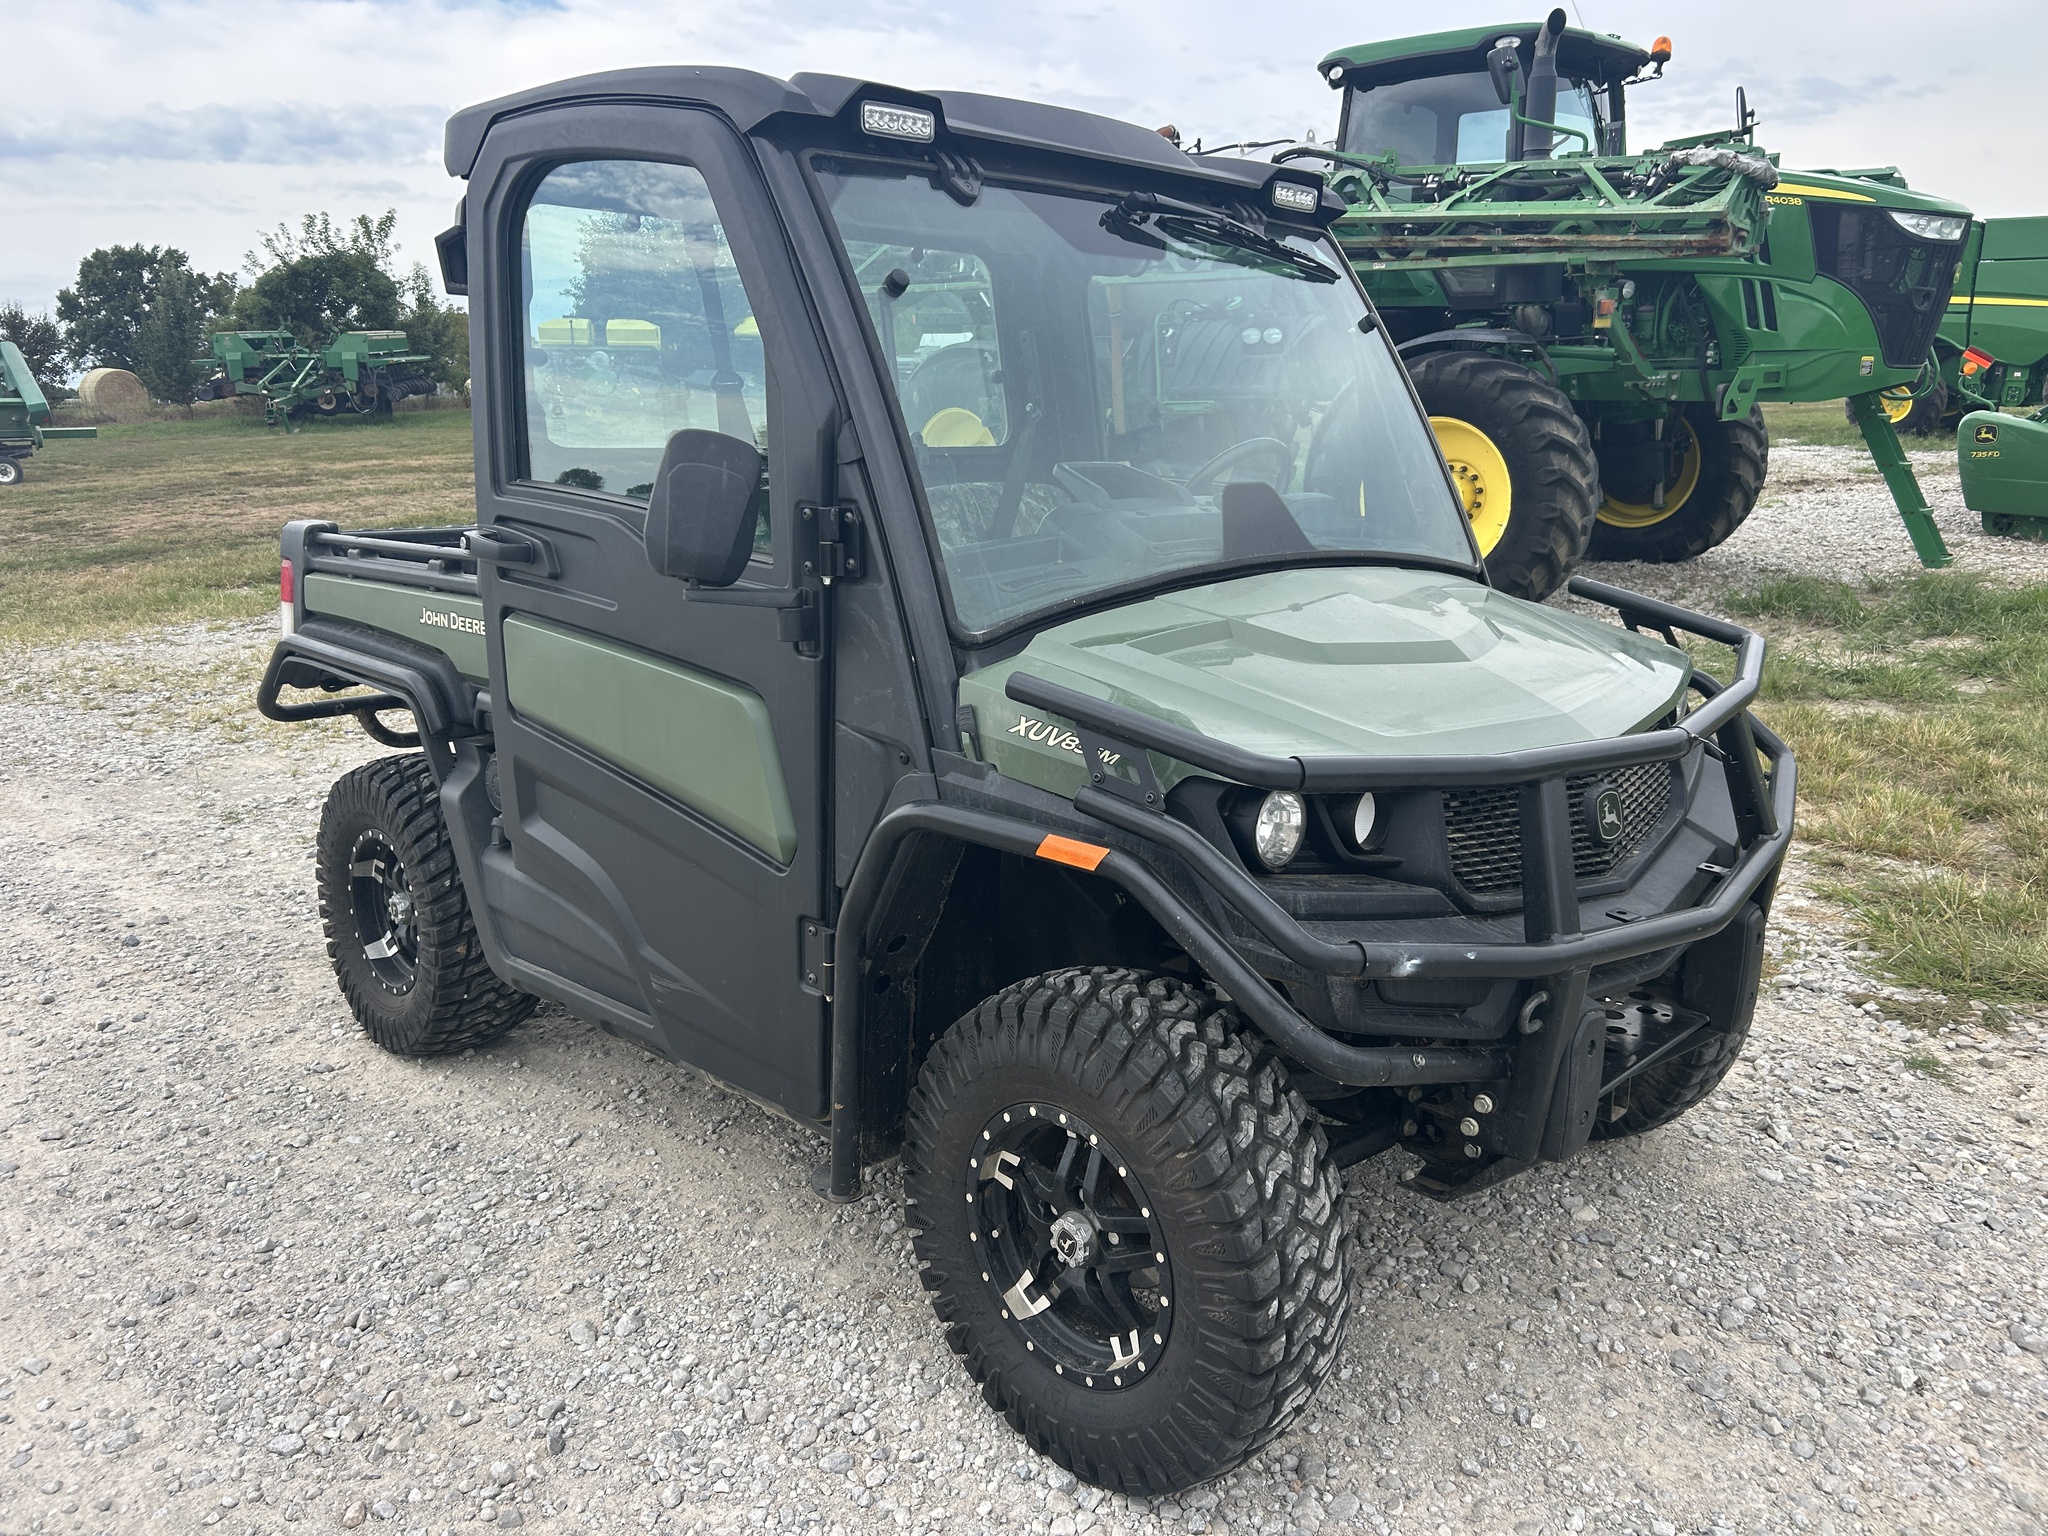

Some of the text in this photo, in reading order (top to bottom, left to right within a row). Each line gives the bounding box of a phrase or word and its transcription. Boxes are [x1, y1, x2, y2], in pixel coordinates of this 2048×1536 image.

[1764, 195, 1802, 206] R4038
[419, 606, 486, 636] JOHN DEERE
[1007, 715, 1121, 765] XUV8M
